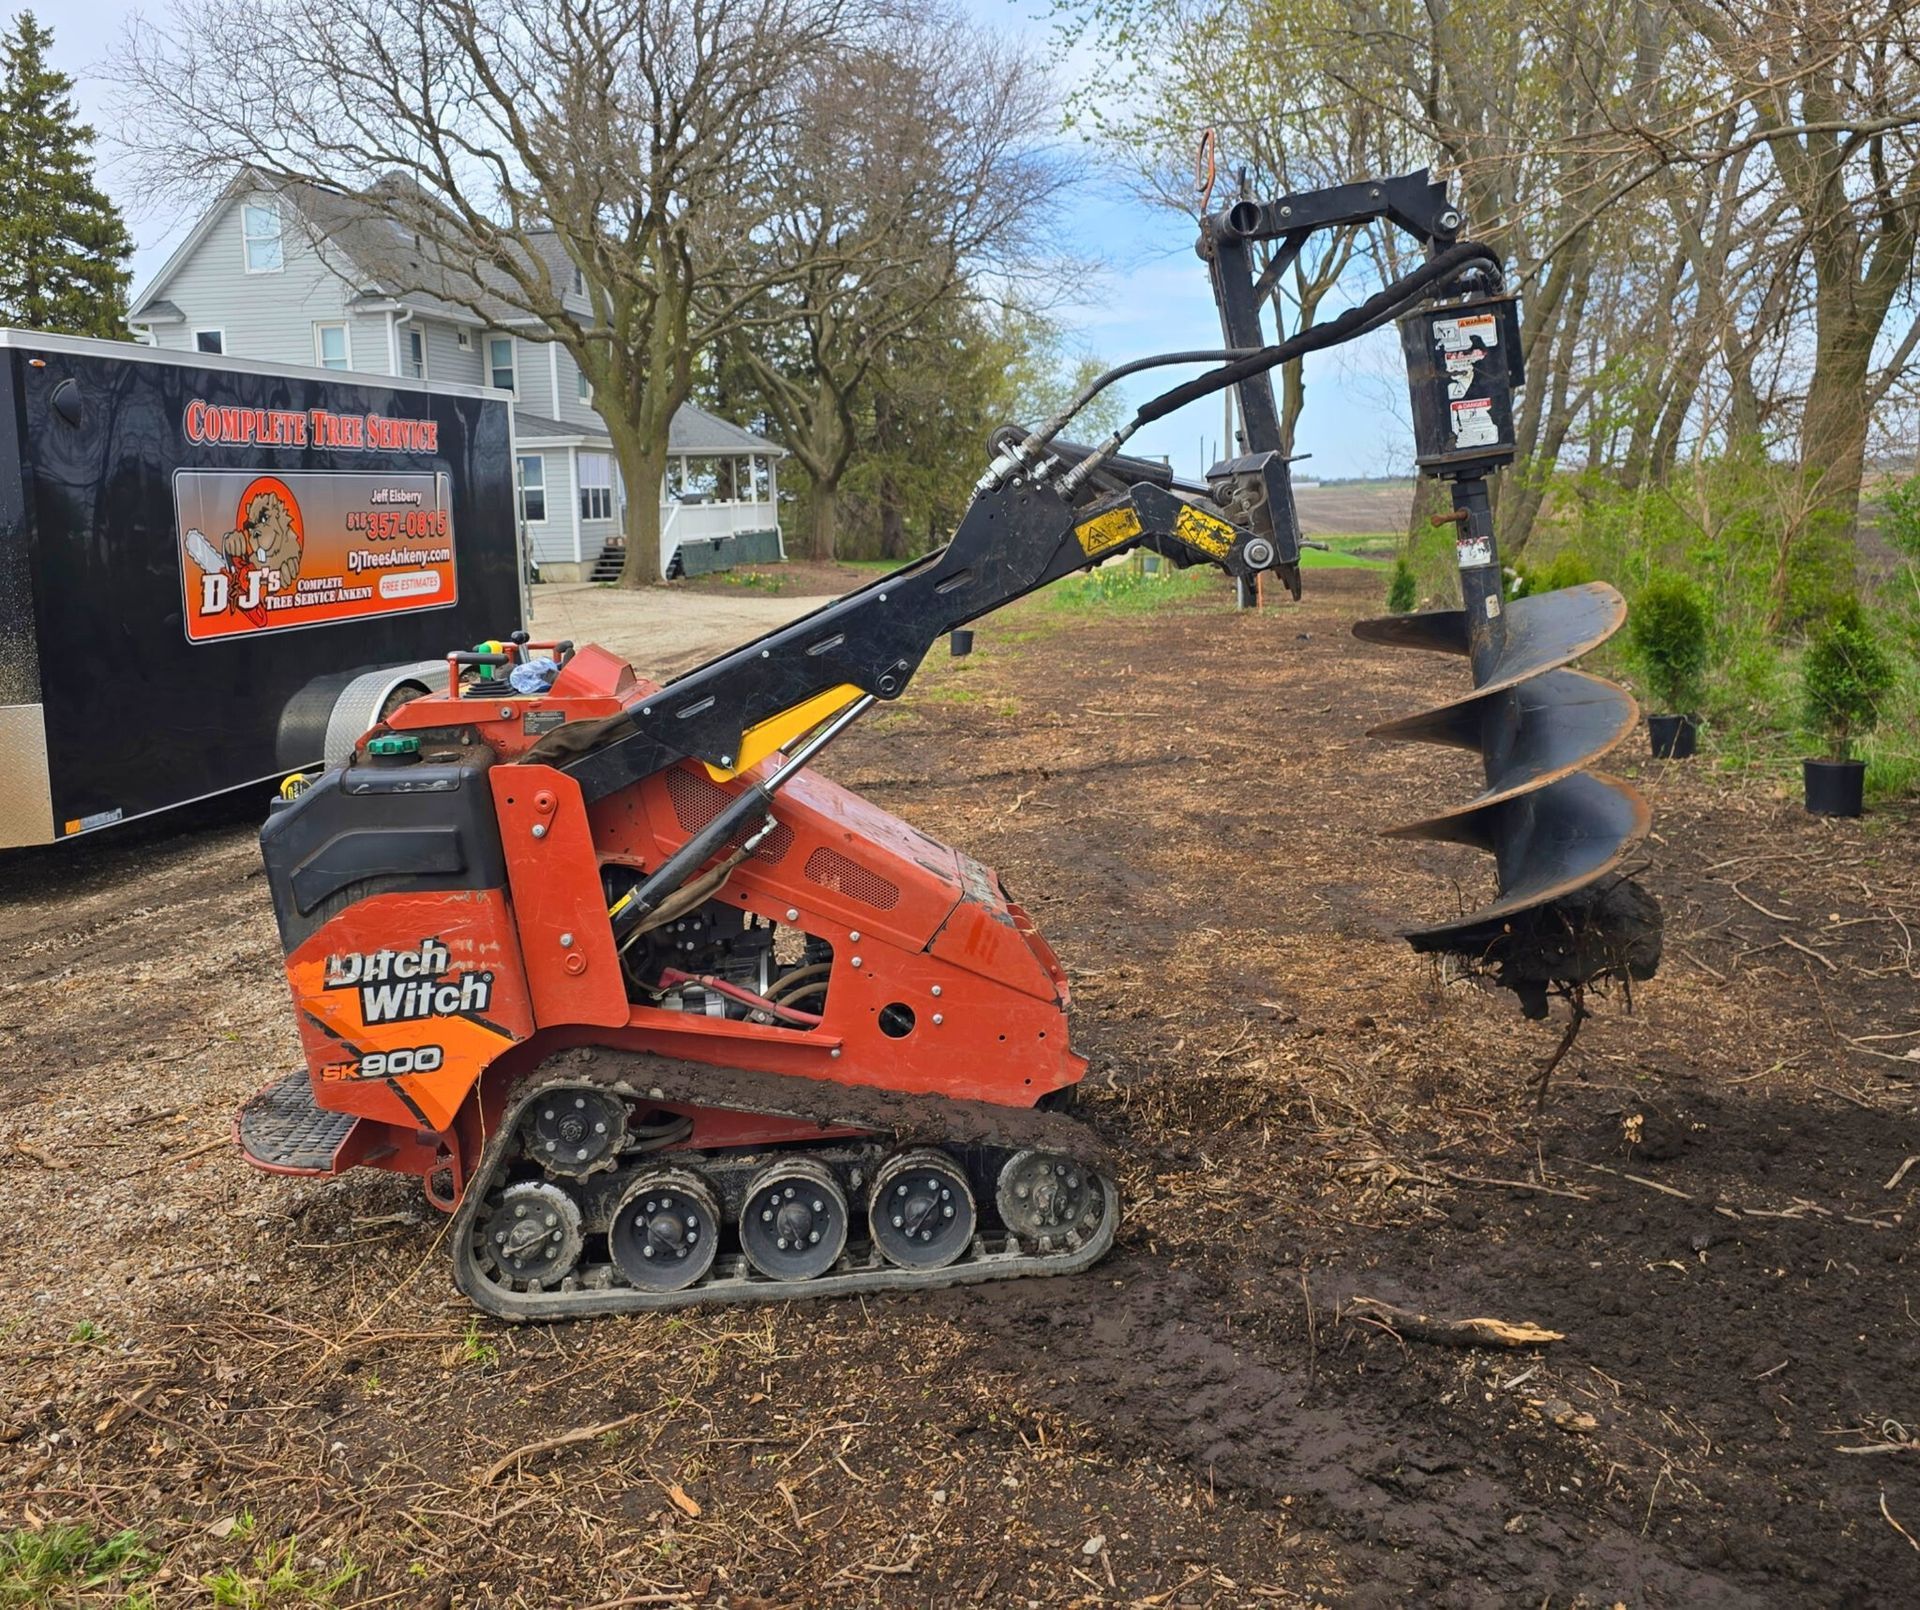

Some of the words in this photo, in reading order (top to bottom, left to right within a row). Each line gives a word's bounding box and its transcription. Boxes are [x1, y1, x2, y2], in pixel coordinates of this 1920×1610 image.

[185, 400, 307, 446] COMPLETE
[311, 410, 364, 448] TREE
[366, 413, 438, 451] SERVICE
[371, 488, 388, 504] Jeff
[348, 546, 450, 574] DjTreesAnkeny.com
[298, 576, 343, 592] COMPLETE
[381, 579, 400, 592] FREE
[400, 576, 438, 591] ESTIMATES
[265, 594, 293, 610] TREE
[294, 589, 336, 607] SERVICE
[337, 586, 373, 602] ANKENY
[326, 939, 448, 987] Ditch
